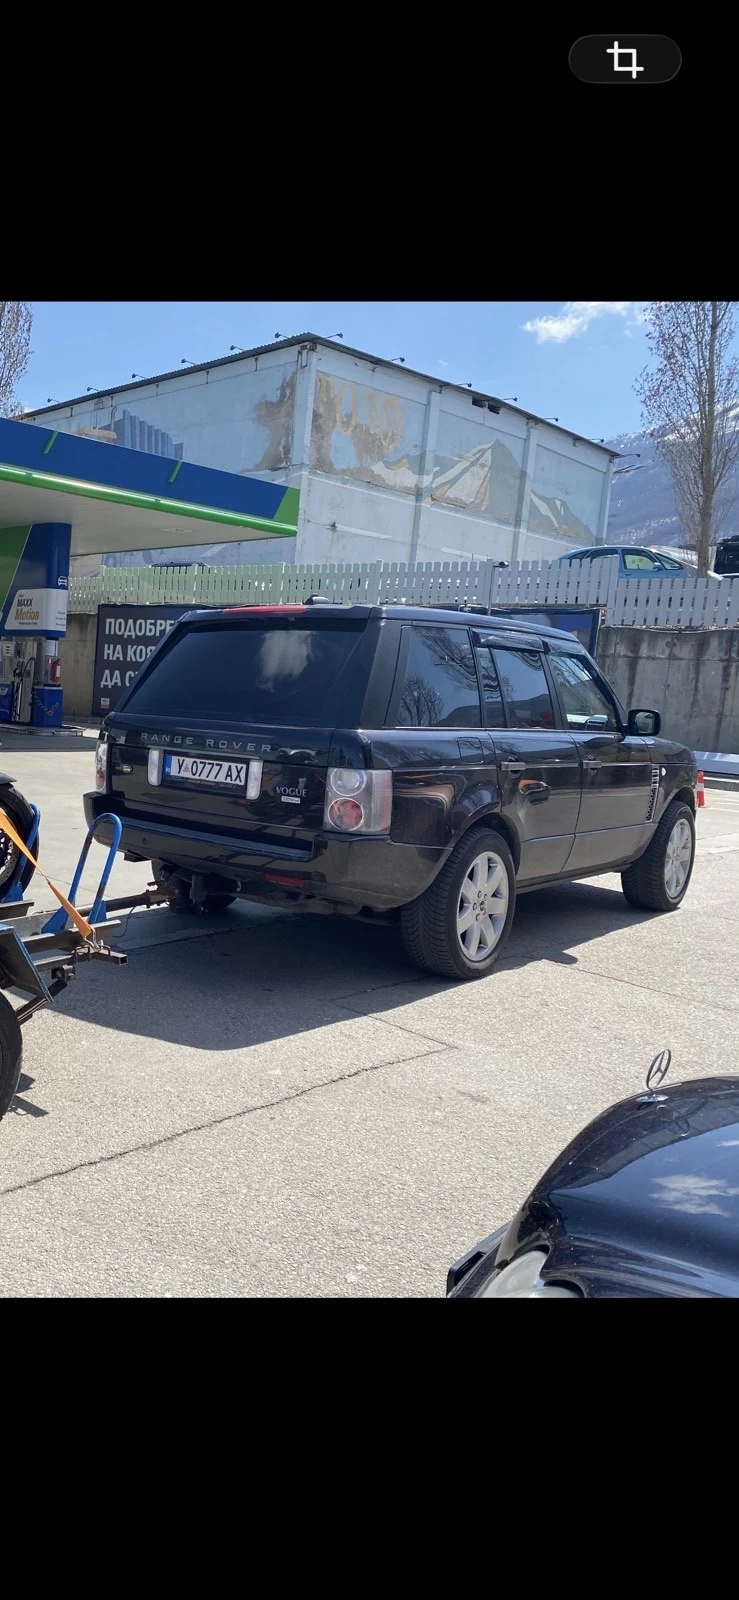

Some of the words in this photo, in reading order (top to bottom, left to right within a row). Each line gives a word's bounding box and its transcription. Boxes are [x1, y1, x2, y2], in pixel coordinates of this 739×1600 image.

[17, 598, 33, 607] MAXX
[15, 608, 40, 621] Motion
[103, 644, 124, 661] НА
[100, 669, 122, 689] ДА
[140, 732, 194, 745] RANGE
[205, 739, 272, 753] ROVER
[190, 760, 223, 780] 0777
[275, 786, 308, 797] VOGUE
